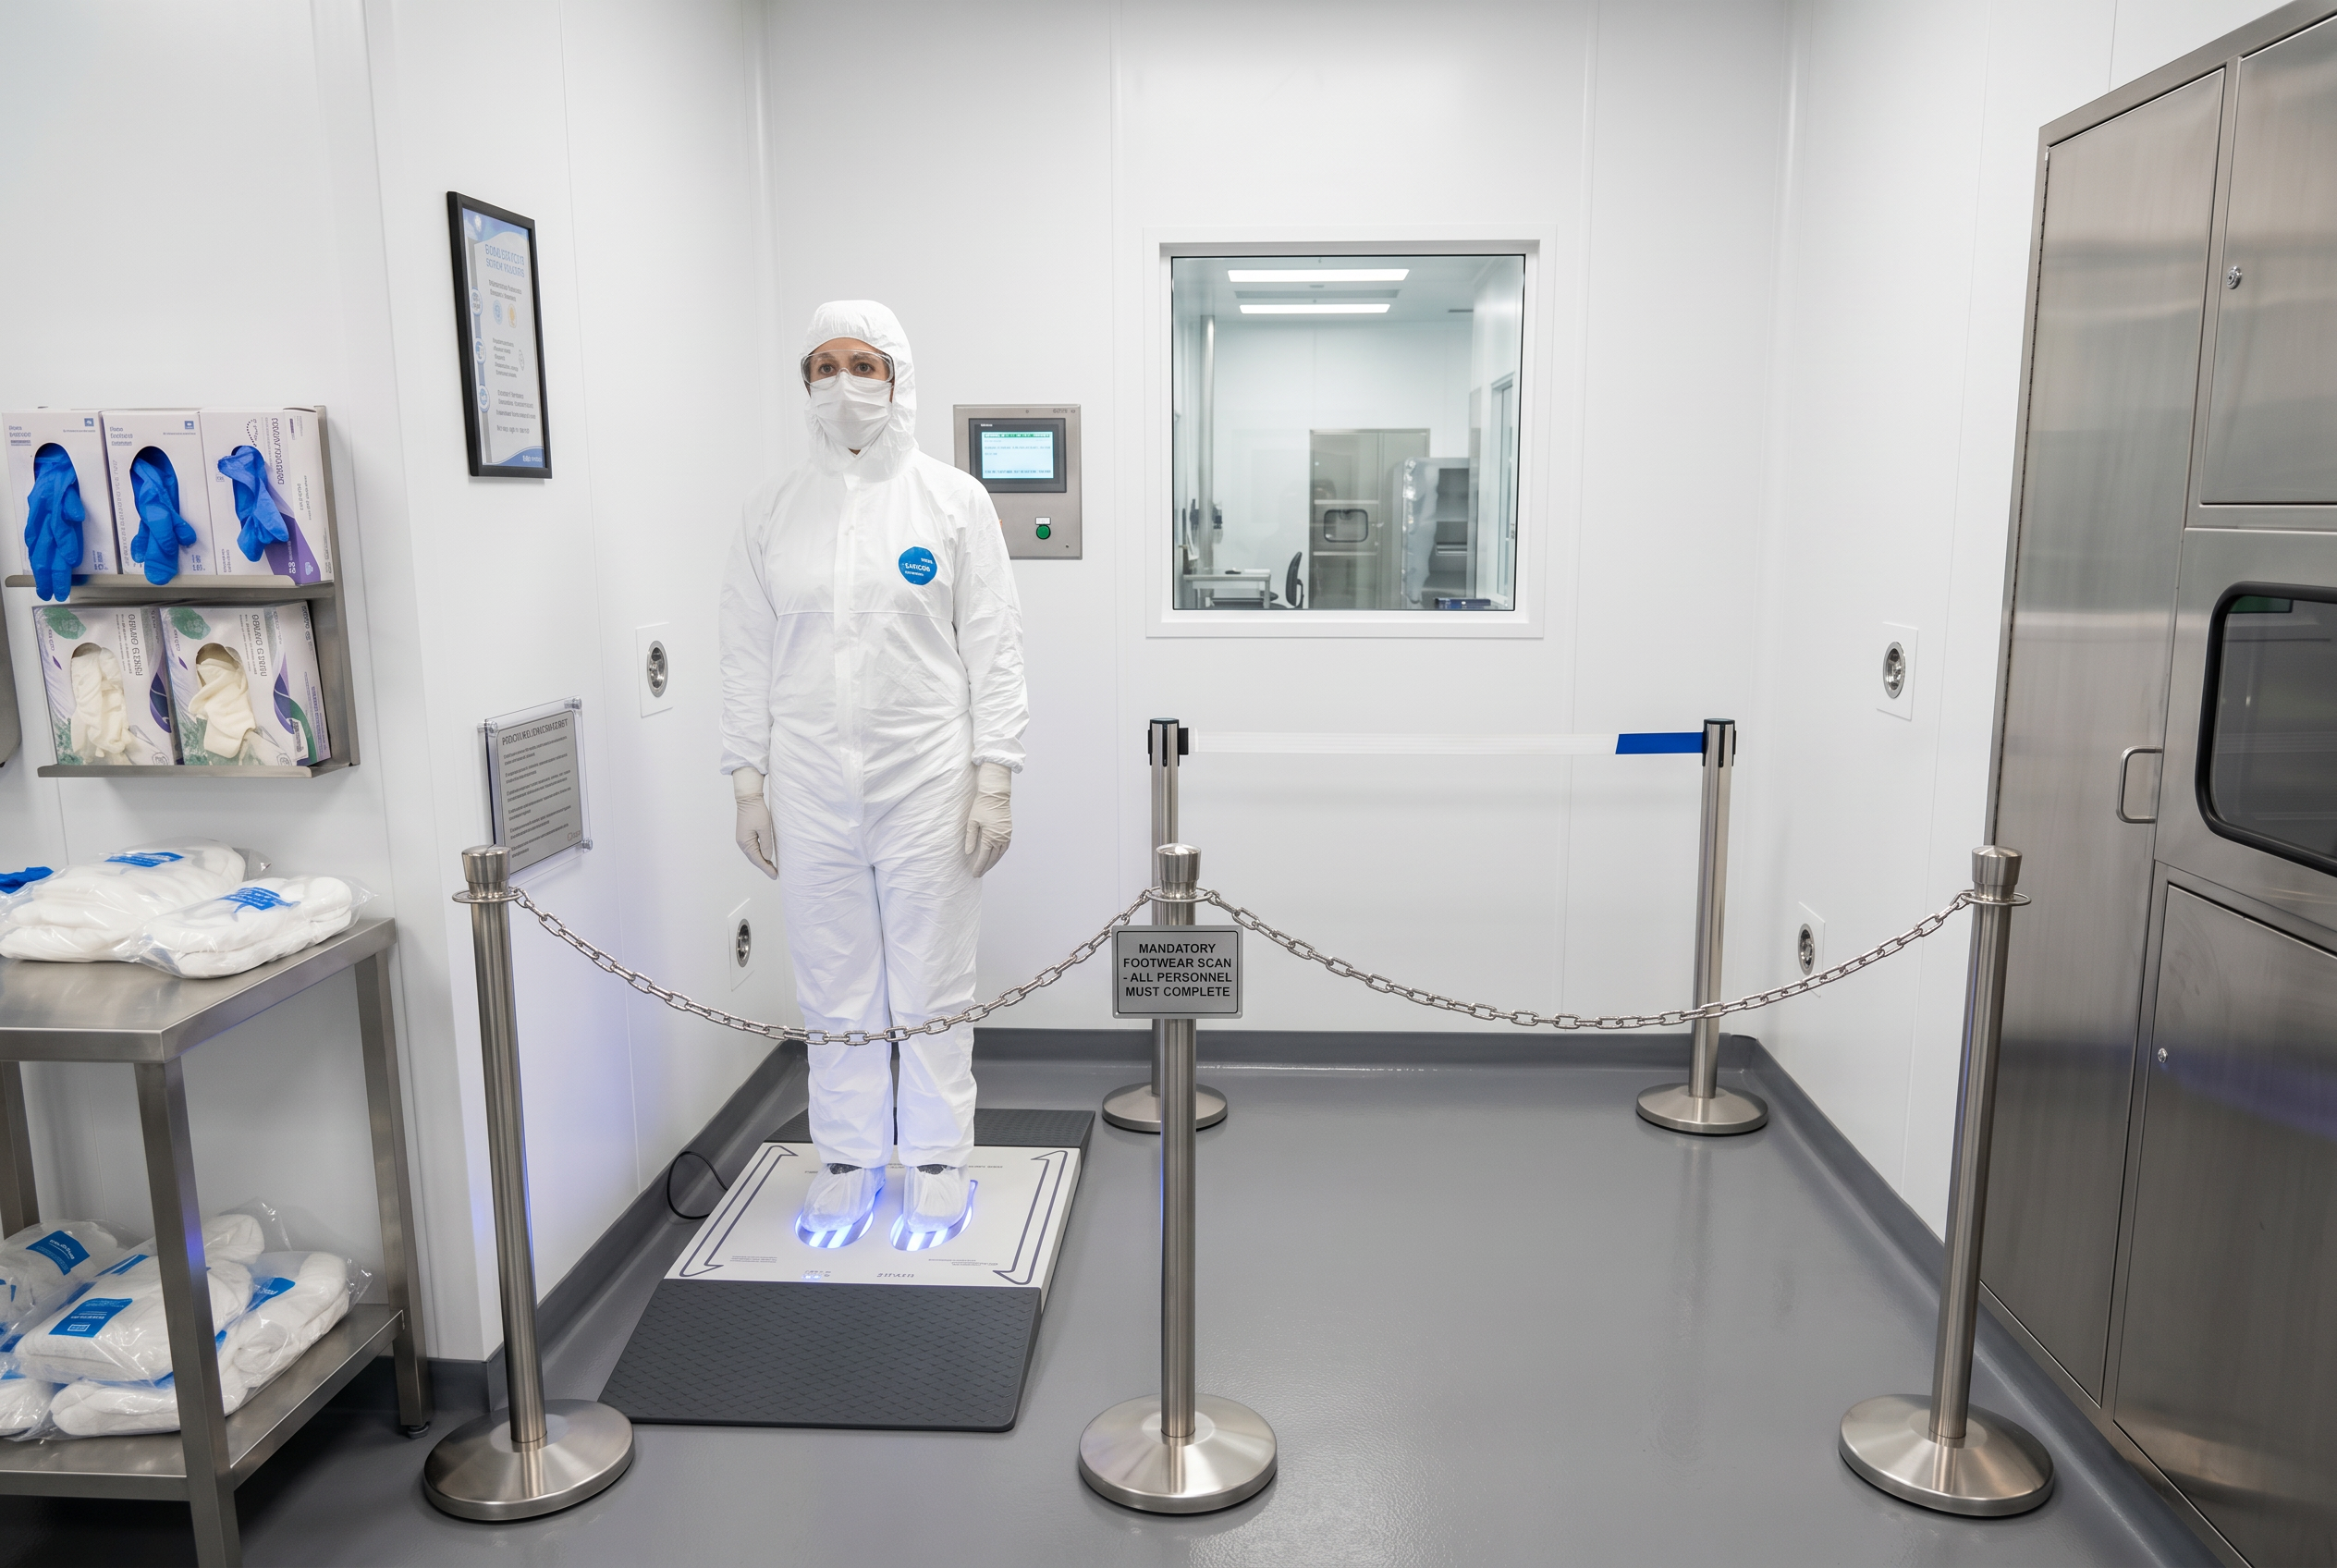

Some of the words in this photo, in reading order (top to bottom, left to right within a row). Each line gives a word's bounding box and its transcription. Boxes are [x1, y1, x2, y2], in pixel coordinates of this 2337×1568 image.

[1139, 943, 1217, 954] MANDATORY
[1123, 958, 1194, 968] FOOTWEAR
[1197, 958, 1231, 968] SCAN
[1130, 973, 1154, 983] ALL
[1157, 973, 1232, 983] PERSONNEL
[1125, 986, 1159, 997] MUST
[1163, 986, 1230, 997] COMPLETE
